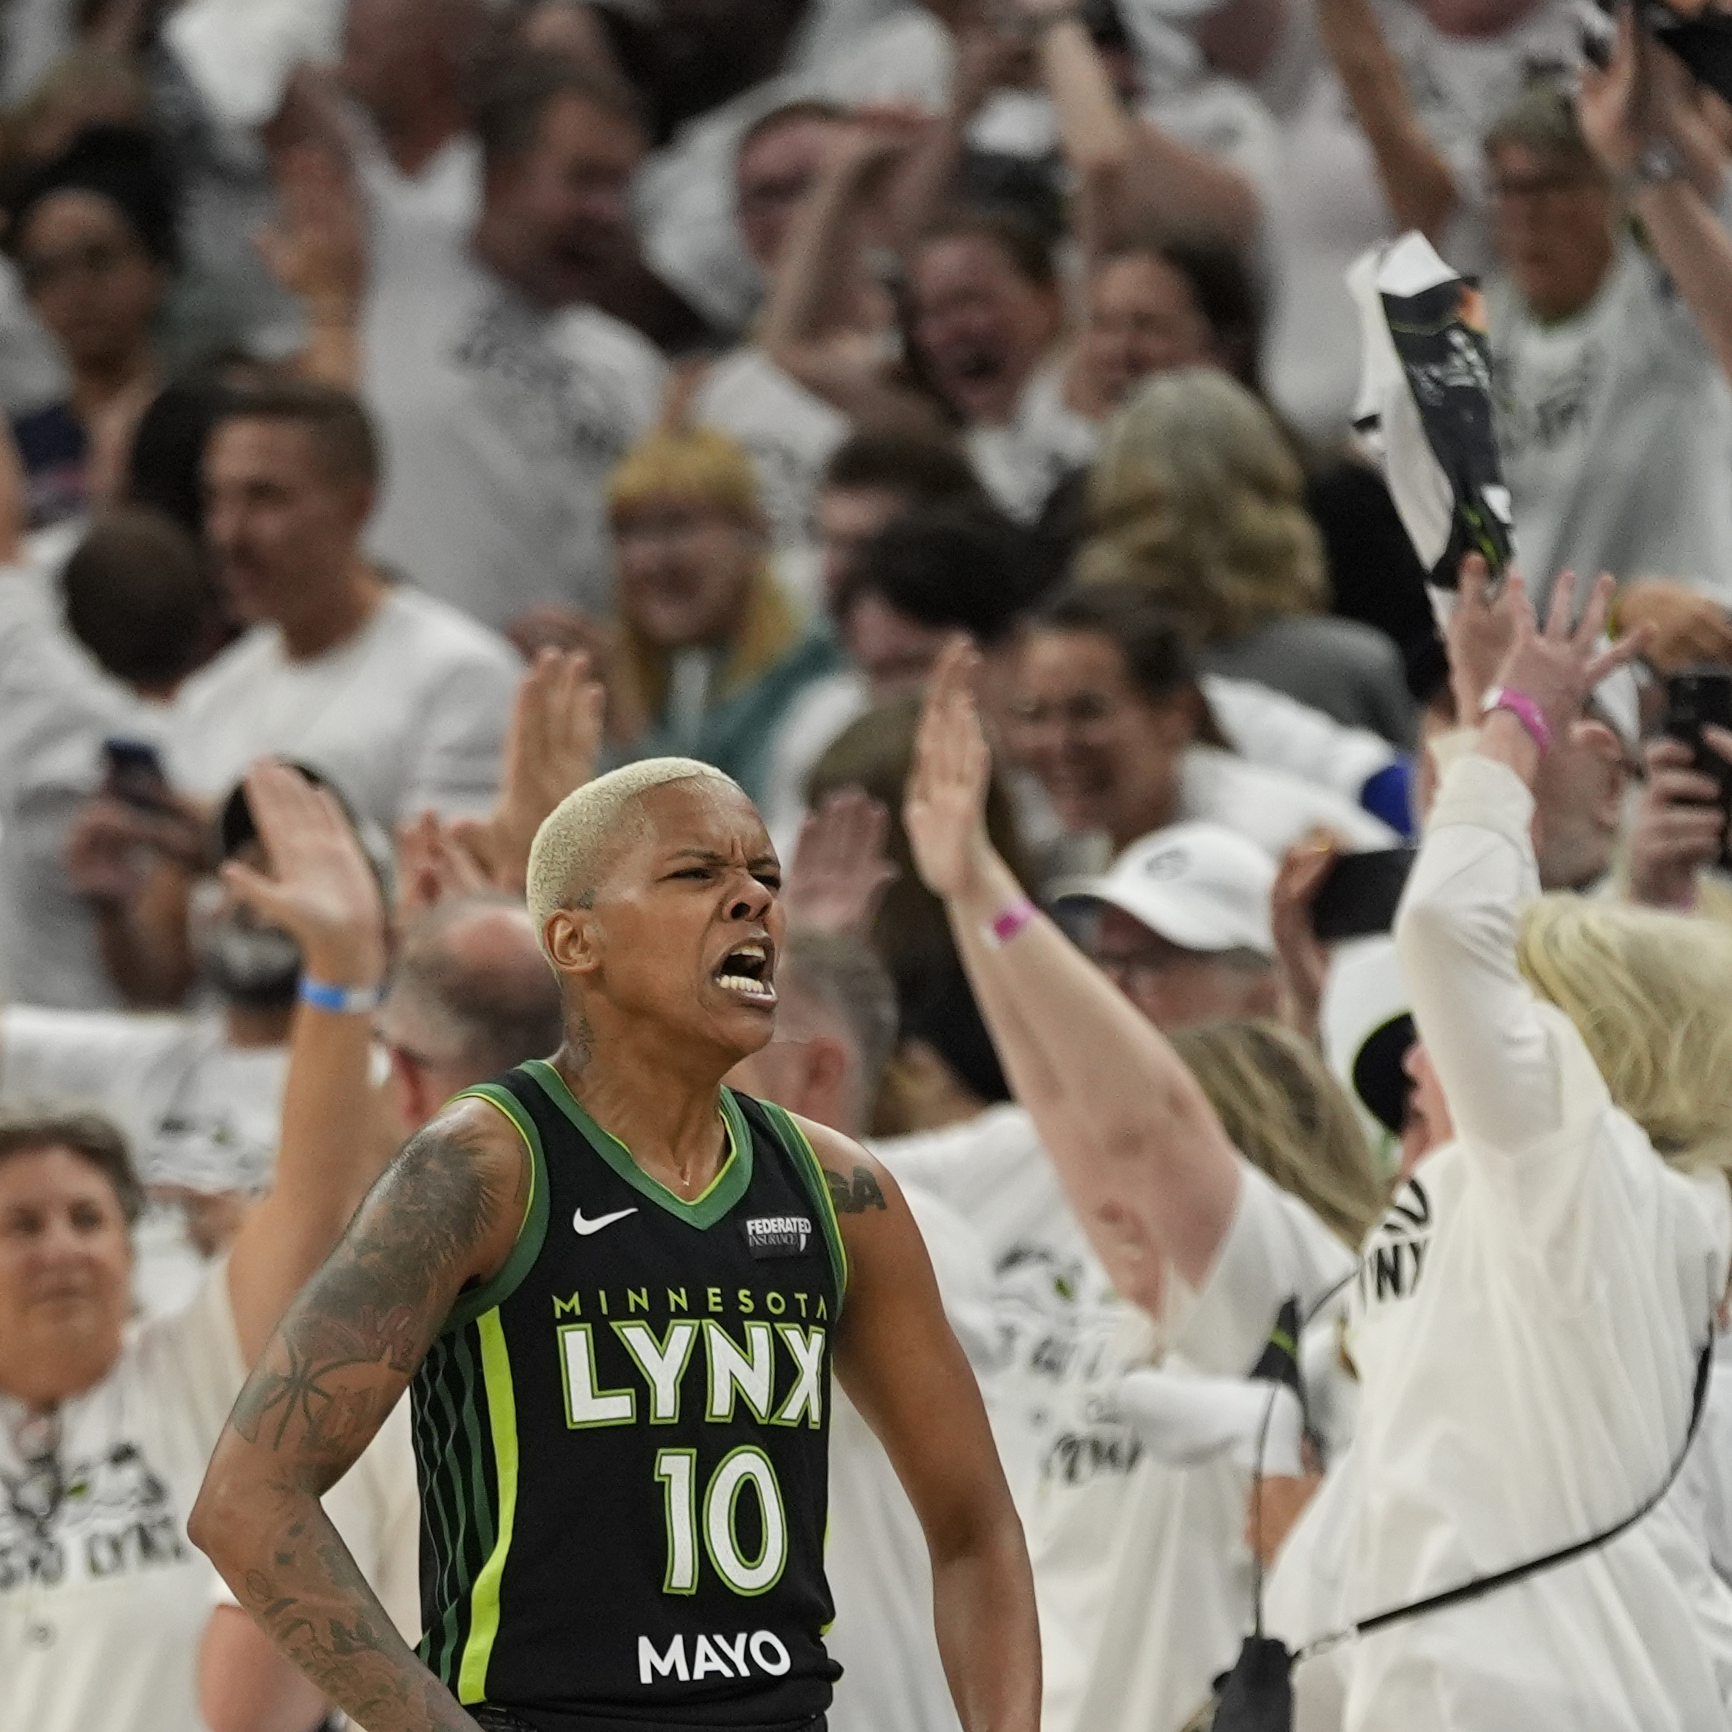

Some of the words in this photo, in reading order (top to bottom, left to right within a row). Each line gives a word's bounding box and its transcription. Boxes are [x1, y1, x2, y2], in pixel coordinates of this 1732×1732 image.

[746, 1217, 811, 1235] FEDERATED
[552, 1286, 828, 1320] MINNESOTA
[557, 1318, 825, 1430] LYNX
[655, 1443, 788, 1597] 10
[638, 1630, 791, 1684] MAYO
